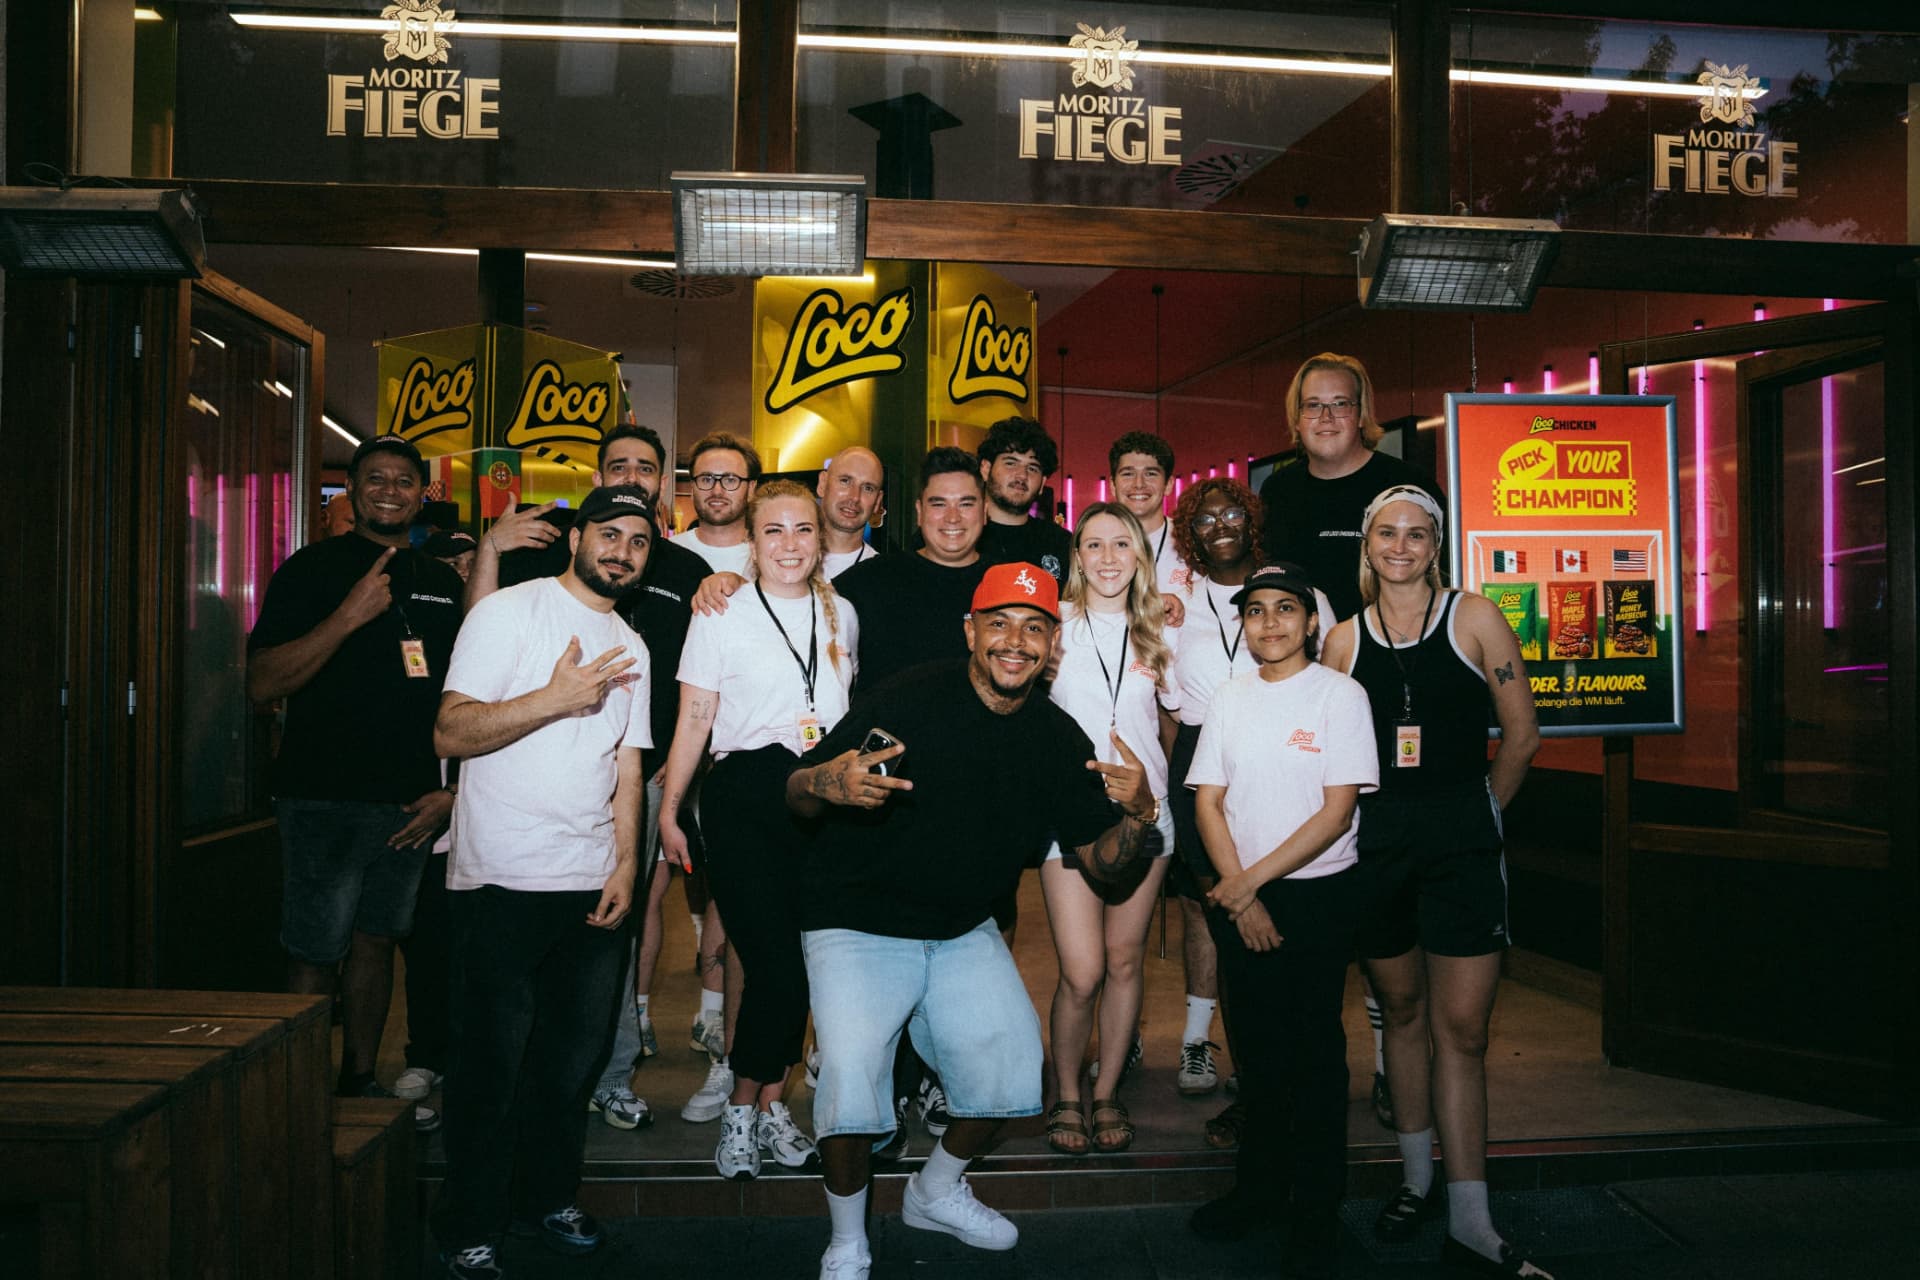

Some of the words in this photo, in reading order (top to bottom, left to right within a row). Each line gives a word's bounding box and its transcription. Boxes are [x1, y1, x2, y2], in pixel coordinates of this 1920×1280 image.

[369, 68, 461, 89] MORITZ
[327, 74, 500, 139] FIEGE
[1058, 93, 1145, 116] MORITZ
[1019, 98, 1182, 166] FIEGE
[1688, 129, 1765, 150] MORITZ
[1654, 133, 1799, 198] FIEGE
[1553, 420, 1597, 430] CHICKEN
[1507, 447, 1547, 476] PICK
[1566, 450, 1622, 474] YOUR
[1506, 489, 1624, 509] CHAMPION
[1564, 676, 1575, 692] 3
[1577, 675, 1647, 692] FLAVOURS.
[1569, 697, 1583, 706] die
[1584, 696, 1603, 706] WM
